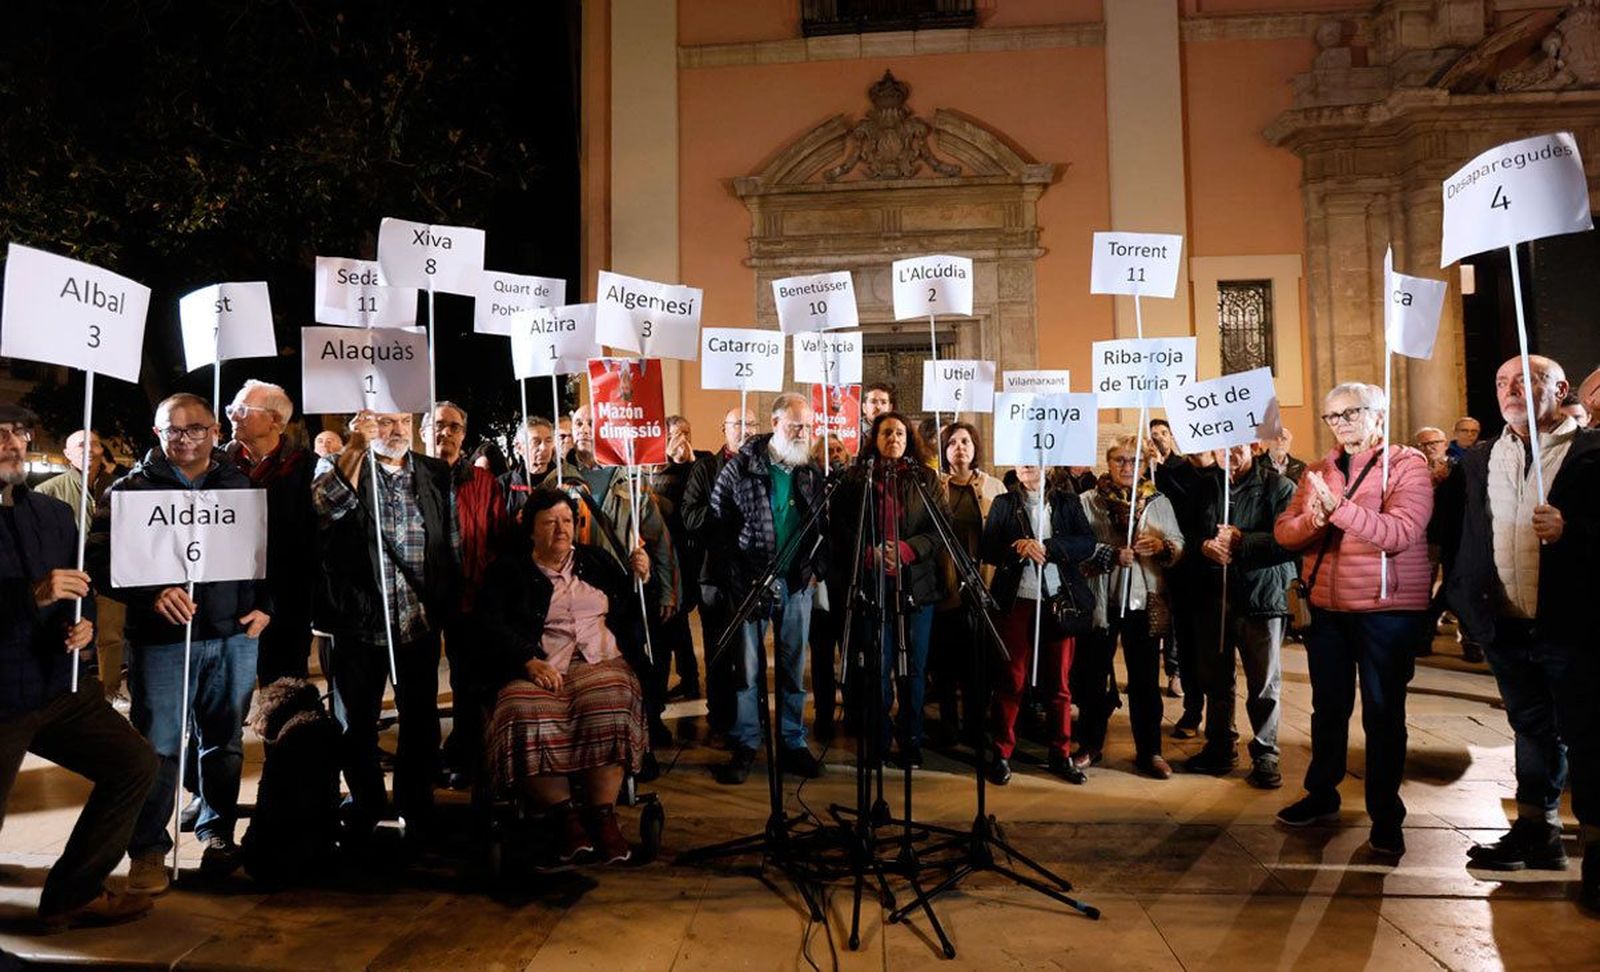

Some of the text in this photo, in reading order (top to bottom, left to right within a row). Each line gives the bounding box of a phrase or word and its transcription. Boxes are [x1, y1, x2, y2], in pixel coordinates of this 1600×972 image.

[1447, 143, 1573, 199] Desaparegudes
[1490, 185, 1511, 211] 4
[412, 228, 453, 250] Xiva
[1108, 241, 1168, 259] Torrent
[424, 258, 437, 275] 8
[899, 264, 967, 283] L'Alcúdia
[1127, 266, 1146, 282] 11
[337, 268, 378, 286] Seda
[60, 276, 125, 315] Albal
[493, 280, 550, 297] Quart de
[780, 280, 848, 298] Benetússer
[927, 288, 937, 302] 2
[215, 296, 233, 314] st
[357, 296, 378, 313] 11
[606, 285, 694, 316] Algemesí
[1393, 290, 1413, 306] ca
[809, 301, 828, 315] 10
[530, 318, 577, 335] Alzira
[641, 320, 653, 338] 3
[86, 325, 101, 348] 3
[321, 340, 415, 364] Alaquàs
[549, 344, 559, 360] 1
[708, 337, 780, 355] Catarroja
[1104, 350, 1183, 368] Riba-roja
[735, 363, 754, 377] 25
[943, 368, 975, 382] Utiel
[364, 375, 377, 394] 1
[1100, 374, 1187, 392] de Túria 7
[954, 389, 963, 401] 6
[1185, 385, 1251, 412] Sot de
[598, 402, 644, 420] Mazón
[1010, 403, 1081, 425] Picanya
[600, 420, 661, 439] dimissió
[1189, 412, 1260, 439] Xera 1
[1033, 433, 1055, 450] 10
[147, 504, 236, 527] Aldaia
[186, 541, 201, 562] 6
